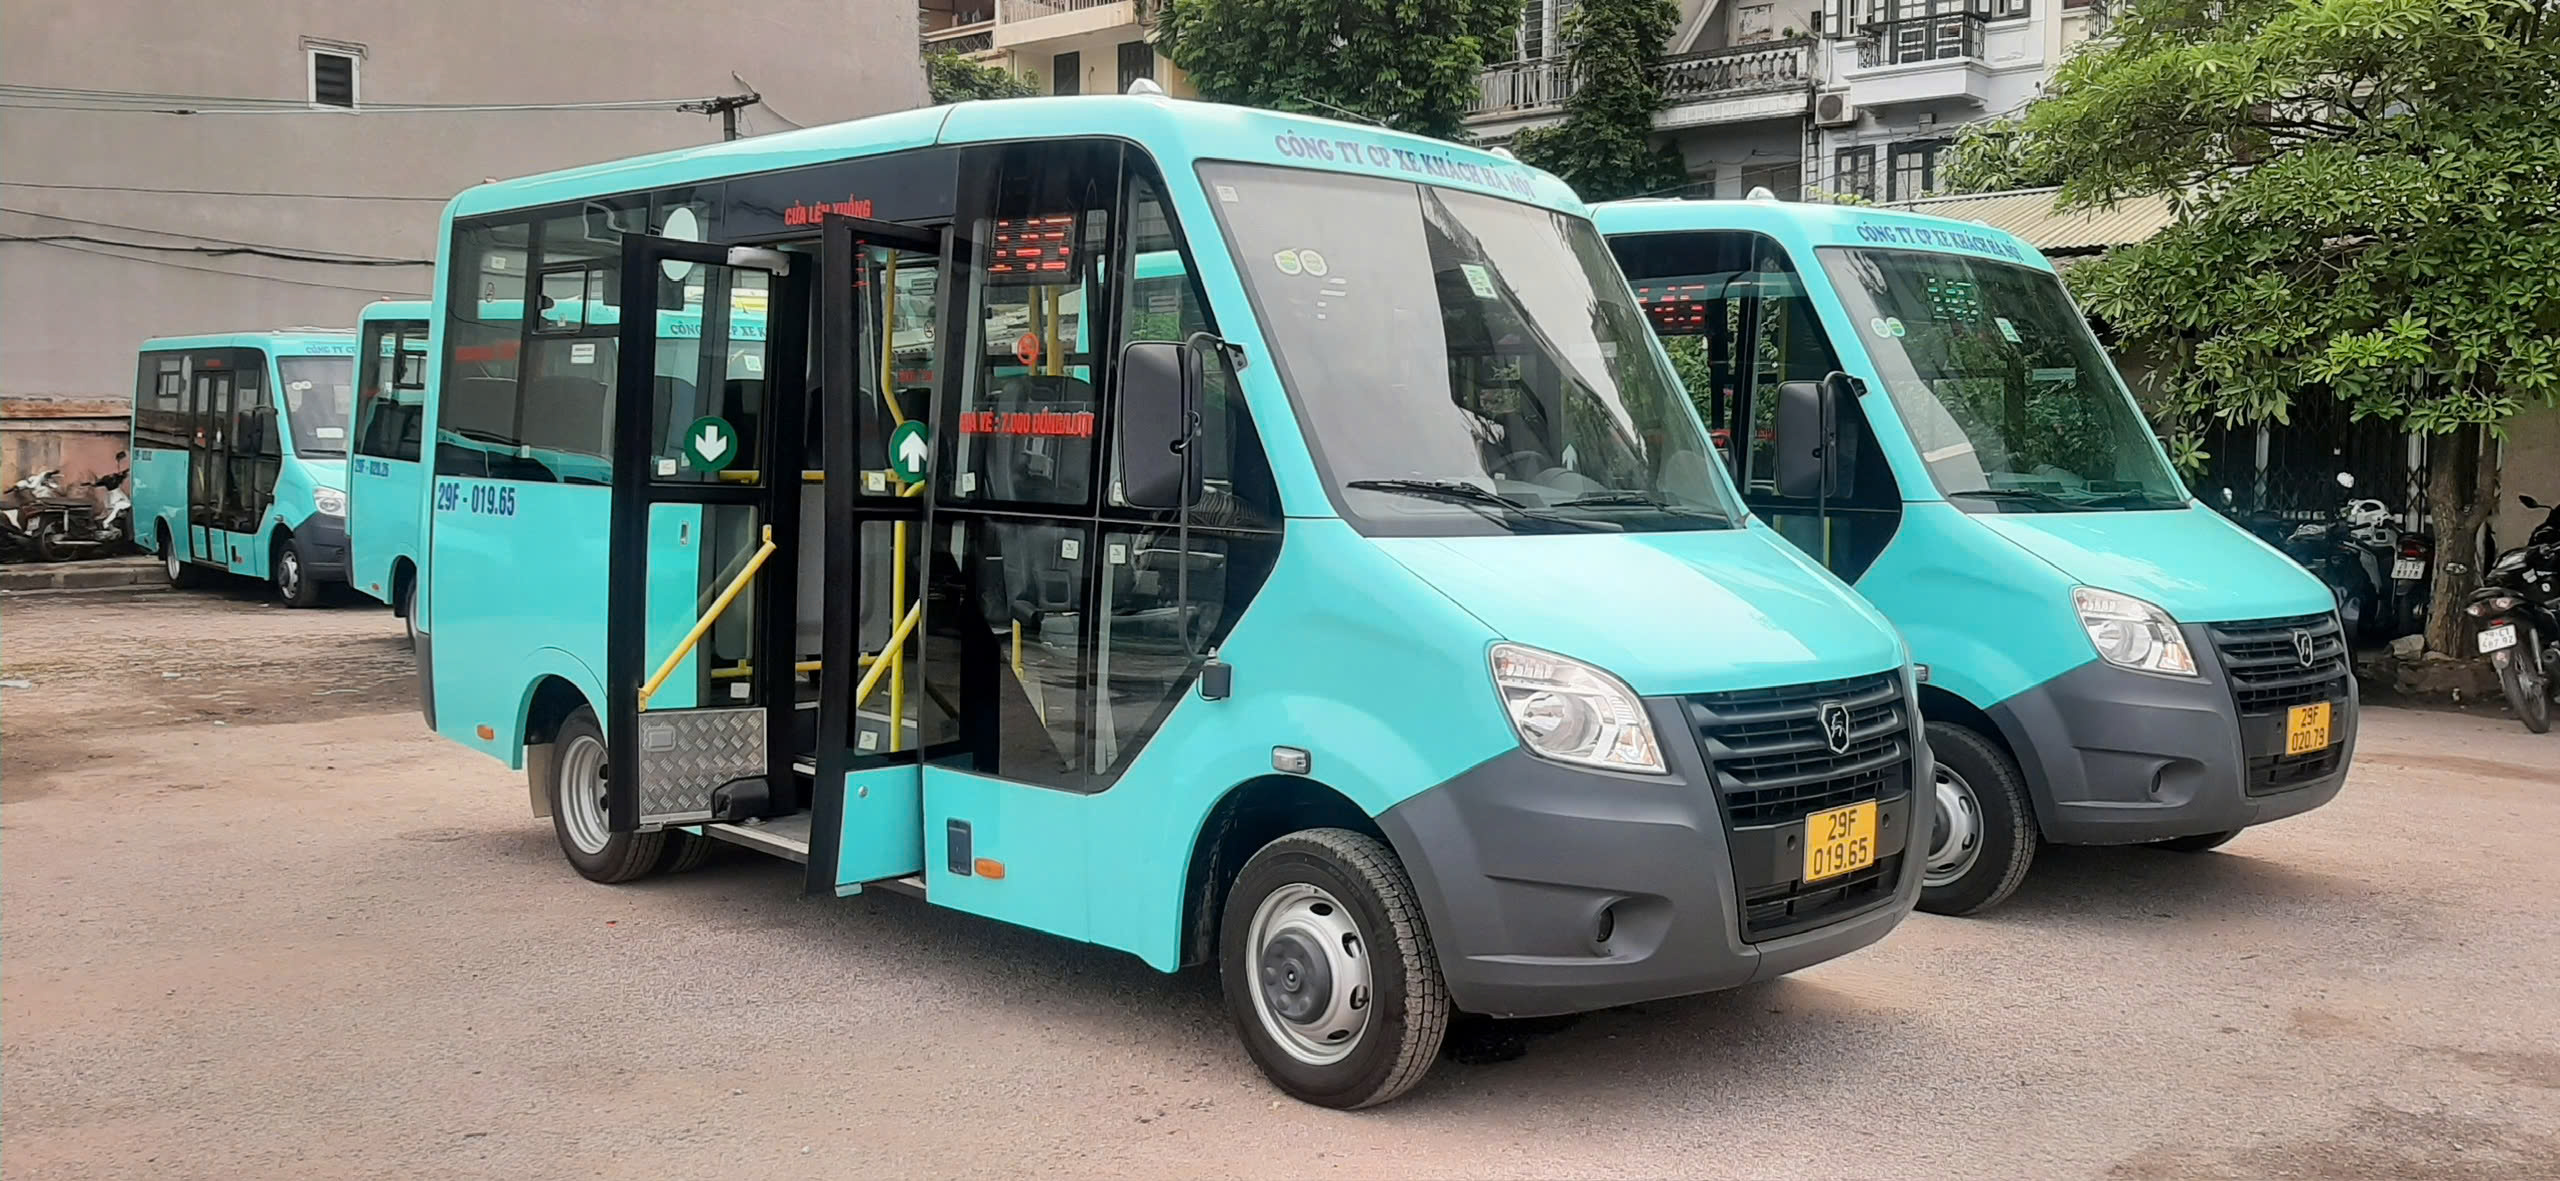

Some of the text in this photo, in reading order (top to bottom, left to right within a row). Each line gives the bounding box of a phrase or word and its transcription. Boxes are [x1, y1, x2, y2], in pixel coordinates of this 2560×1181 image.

[1274, 129, 1537, 201] CÔNG TY CP XE KHÁCH HÀ NỘI
[785, 199, 807, 226] CỬA
[1856, 220, 1896, 243] CÔNG
[1895, 226, 1916, 244] TY
[1914, 228, 1933, 245] CP
[1931, 230, 1953, 248] XE
[1951, 229, 1988, 254] KHÁCH
[740, 325, 758, 338] XE
[437, 482, 460, 511] 29F
[471, 484, 516, 516] 019.65
[2301, 705, 2319, 728] 29F
[2291, 727, 2325, 751] 020.79
[1827, 808, 1857, 842] 29F
[1813, 836, 1868, 875] 019.65
